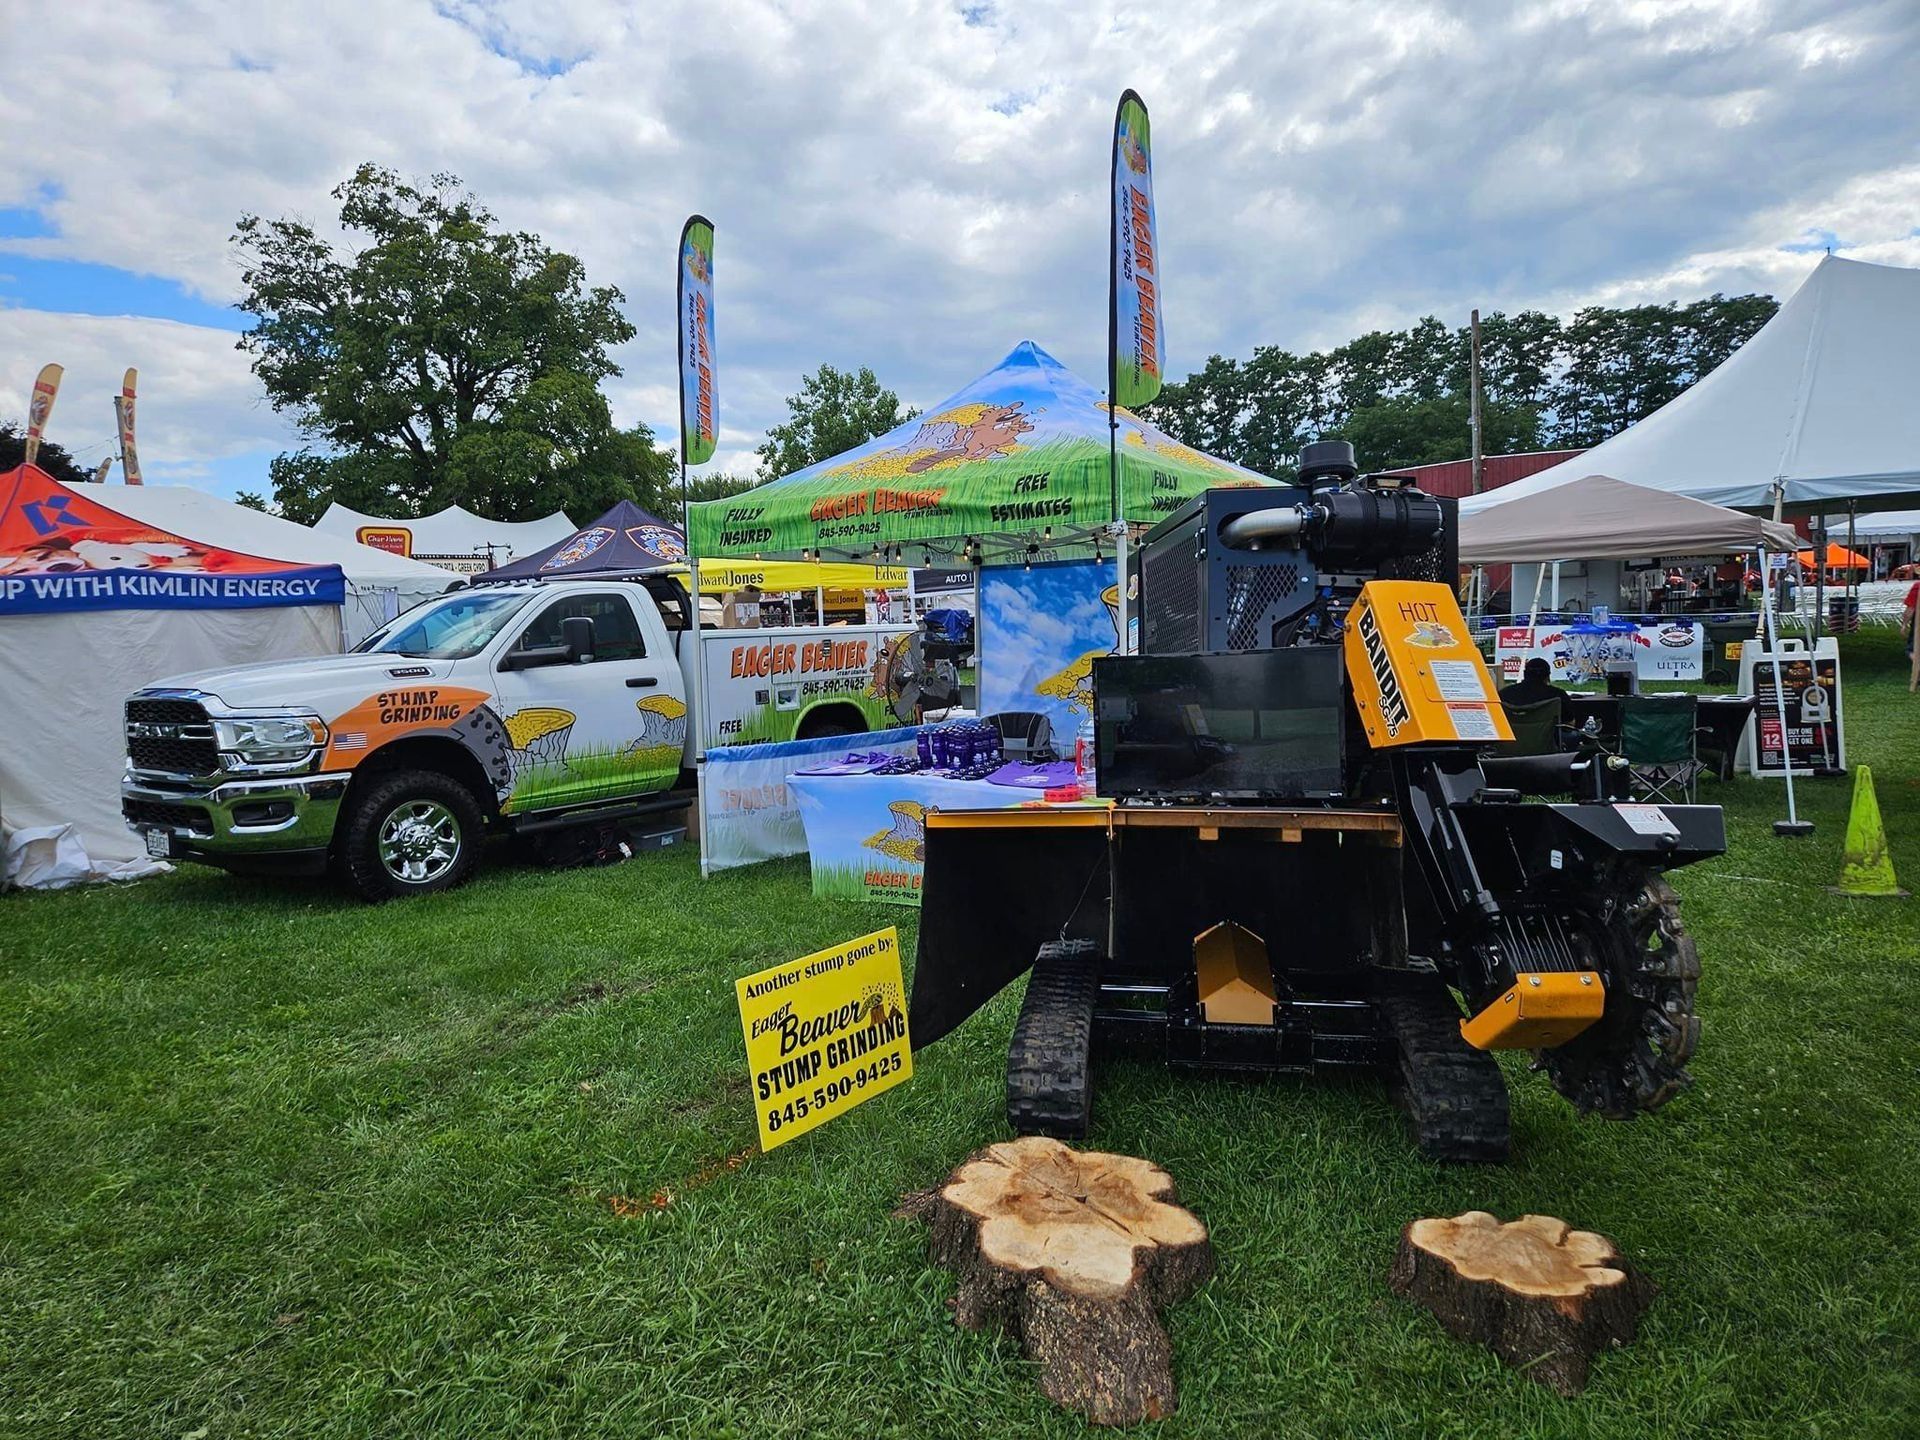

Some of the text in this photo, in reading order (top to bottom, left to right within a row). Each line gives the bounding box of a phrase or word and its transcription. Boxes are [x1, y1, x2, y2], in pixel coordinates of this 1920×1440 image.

[1130, 184, 1157, 378] EAGER BEAVER
[1013, 471, 1050, 495] FREE
[1153, 470, 1178, 491] FULLY
[810, 488, 947, 522] EAGER BEAVER
[990, 497, 1073, 522] ESTIMATES
[1151, 496, 1191, 511] INSURE
[724, 507, 764, 523] FULLY
[719, 528, 772, 547] INSURED
[818, 522, 880, 539] 845-590-9425
[698, 570, 764, 587] dward Jones
[875, 565, 908, 581] Edwar
[945, 573, 967, 584] AUTO
[31, 576, 114, 599] WITH
[119, 575, 218, 596] KIMLIN
[224, 578, 321, 597] ENERGY
[1398, 602, 1438, 622] HOT
[731, 640, 868, 679] EAGER BEAVER
[1359, 608, 1409, 726] BANDIT
[1657, 661, 1696, 670] ULTRA
[802, 679, 865, 696] 845-590-9425
[377, 690, 439, 707] STUMP
[380, 704, 461, 724] GRINDING
[1379, 696, 1398, 737] SG-75
[719, 719, 742, 735] FREE
[1764, 733, 1780, 745] 12
[864, 871, 909, 888] EAGER
[745, 937, 894, 1001] Another stump gone by:
[751, 1001, 793, 1040] Eager
[777, 999, 862, 1057] Beaver
[757, 1013, 905, 1101] STUMP GRINDING
[768, 1053, 902, 1132] 845-590-9425
